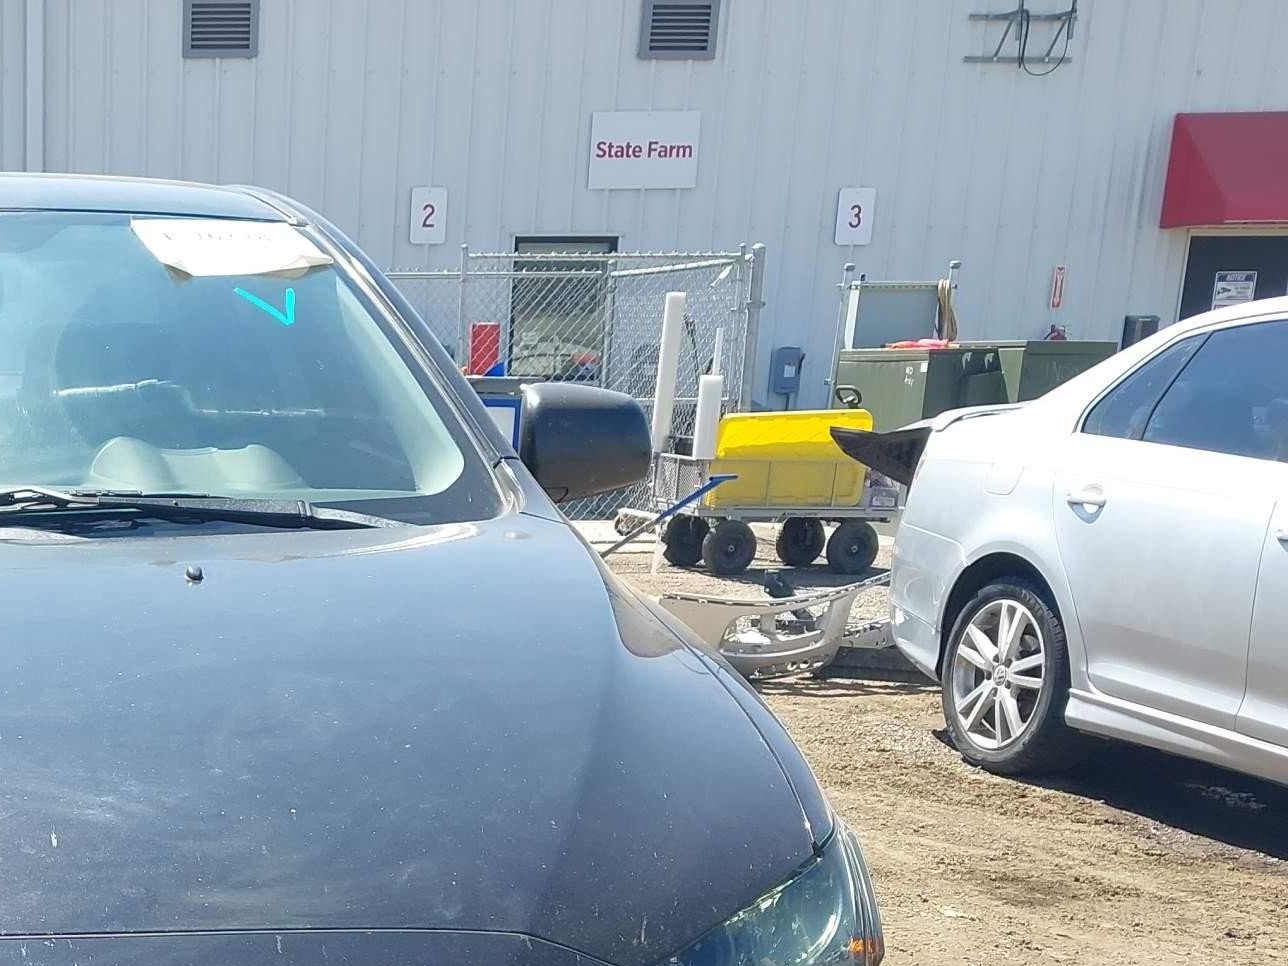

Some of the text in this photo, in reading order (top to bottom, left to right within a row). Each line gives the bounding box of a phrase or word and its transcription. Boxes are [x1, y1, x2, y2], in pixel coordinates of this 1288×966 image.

[595, 140, 694, 160] State Farm
[421, 203, 436, 229] 2
[847, 203, 863, 229] 3
